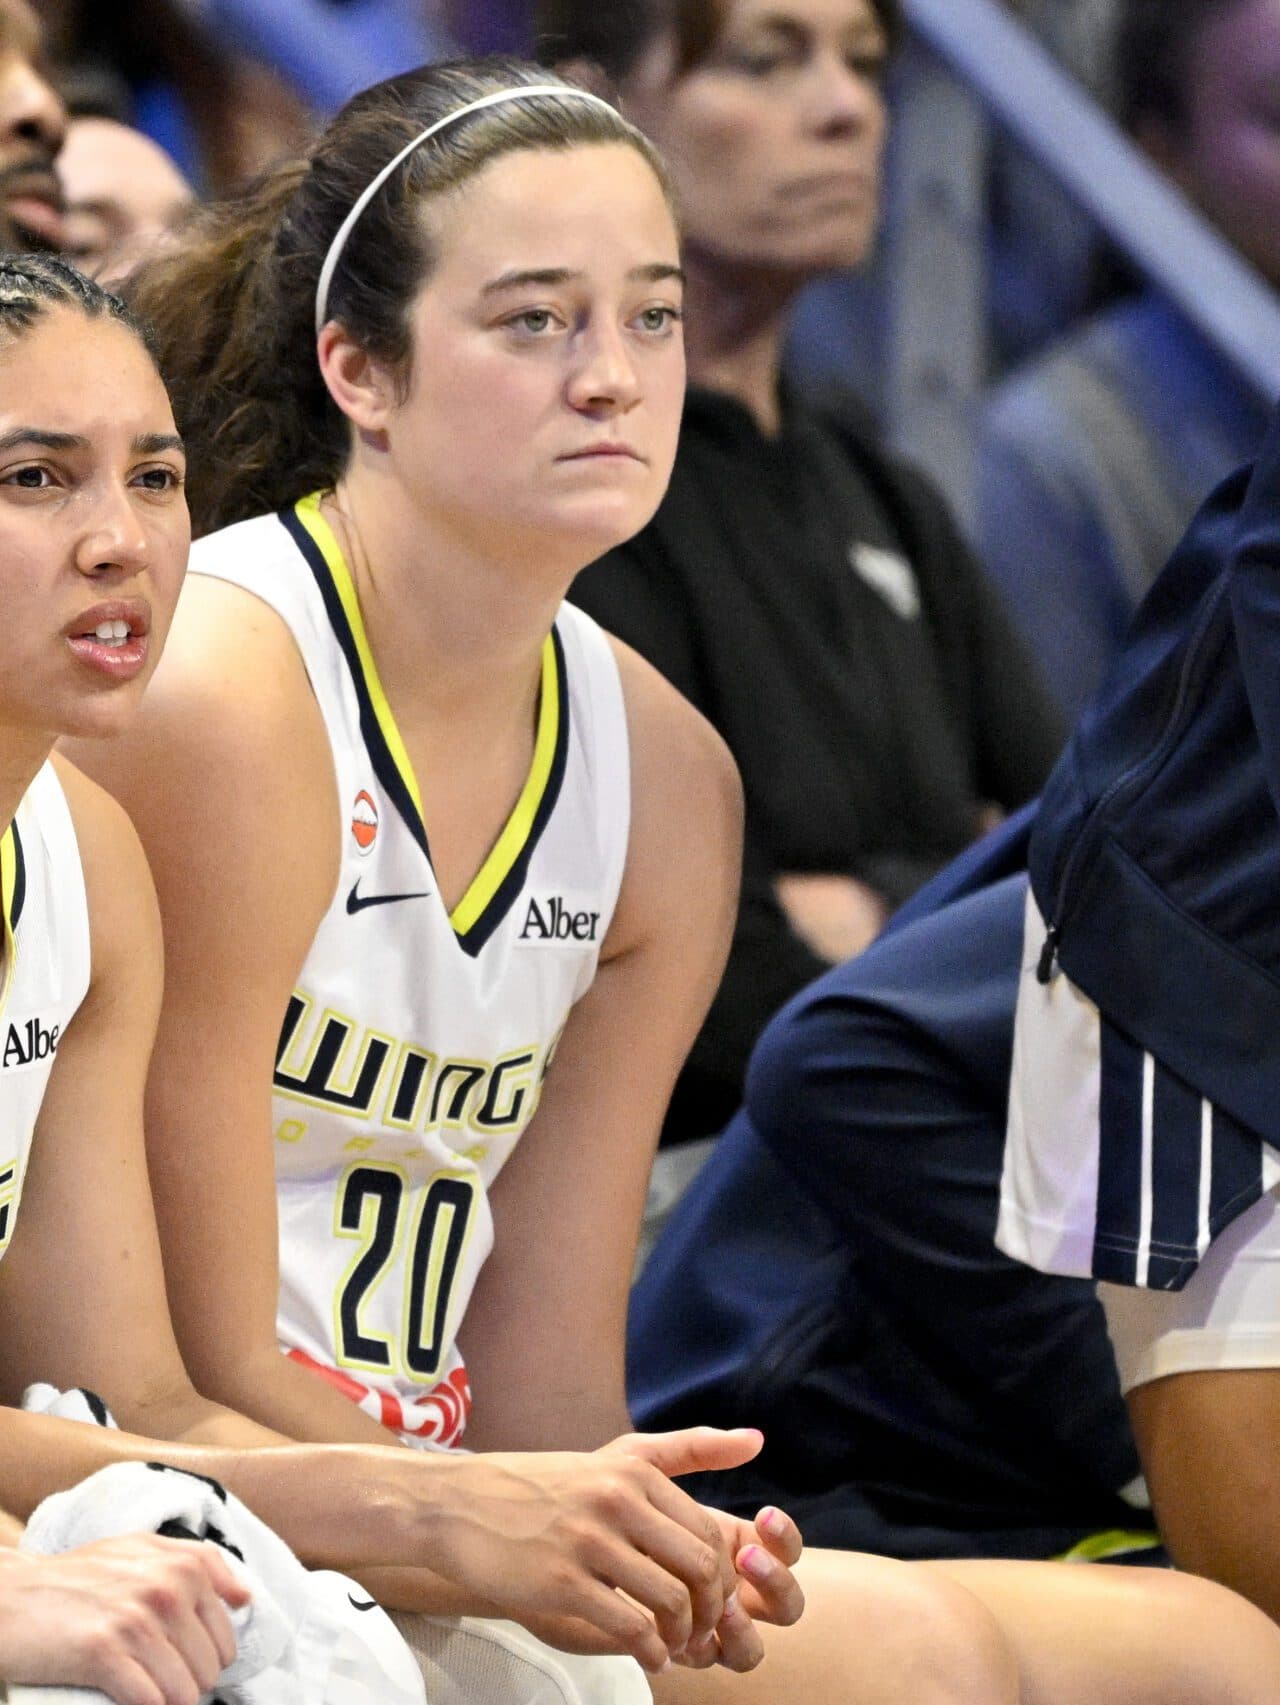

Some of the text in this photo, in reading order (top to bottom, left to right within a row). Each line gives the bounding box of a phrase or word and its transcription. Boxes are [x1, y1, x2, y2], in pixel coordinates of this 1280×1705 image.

[518, 896, 600, 941] Alber
[3, 1017, 60, 1067] Albe
[272, 988, 565, 1135] WING
[333, 1158, 480, 1384] 20
